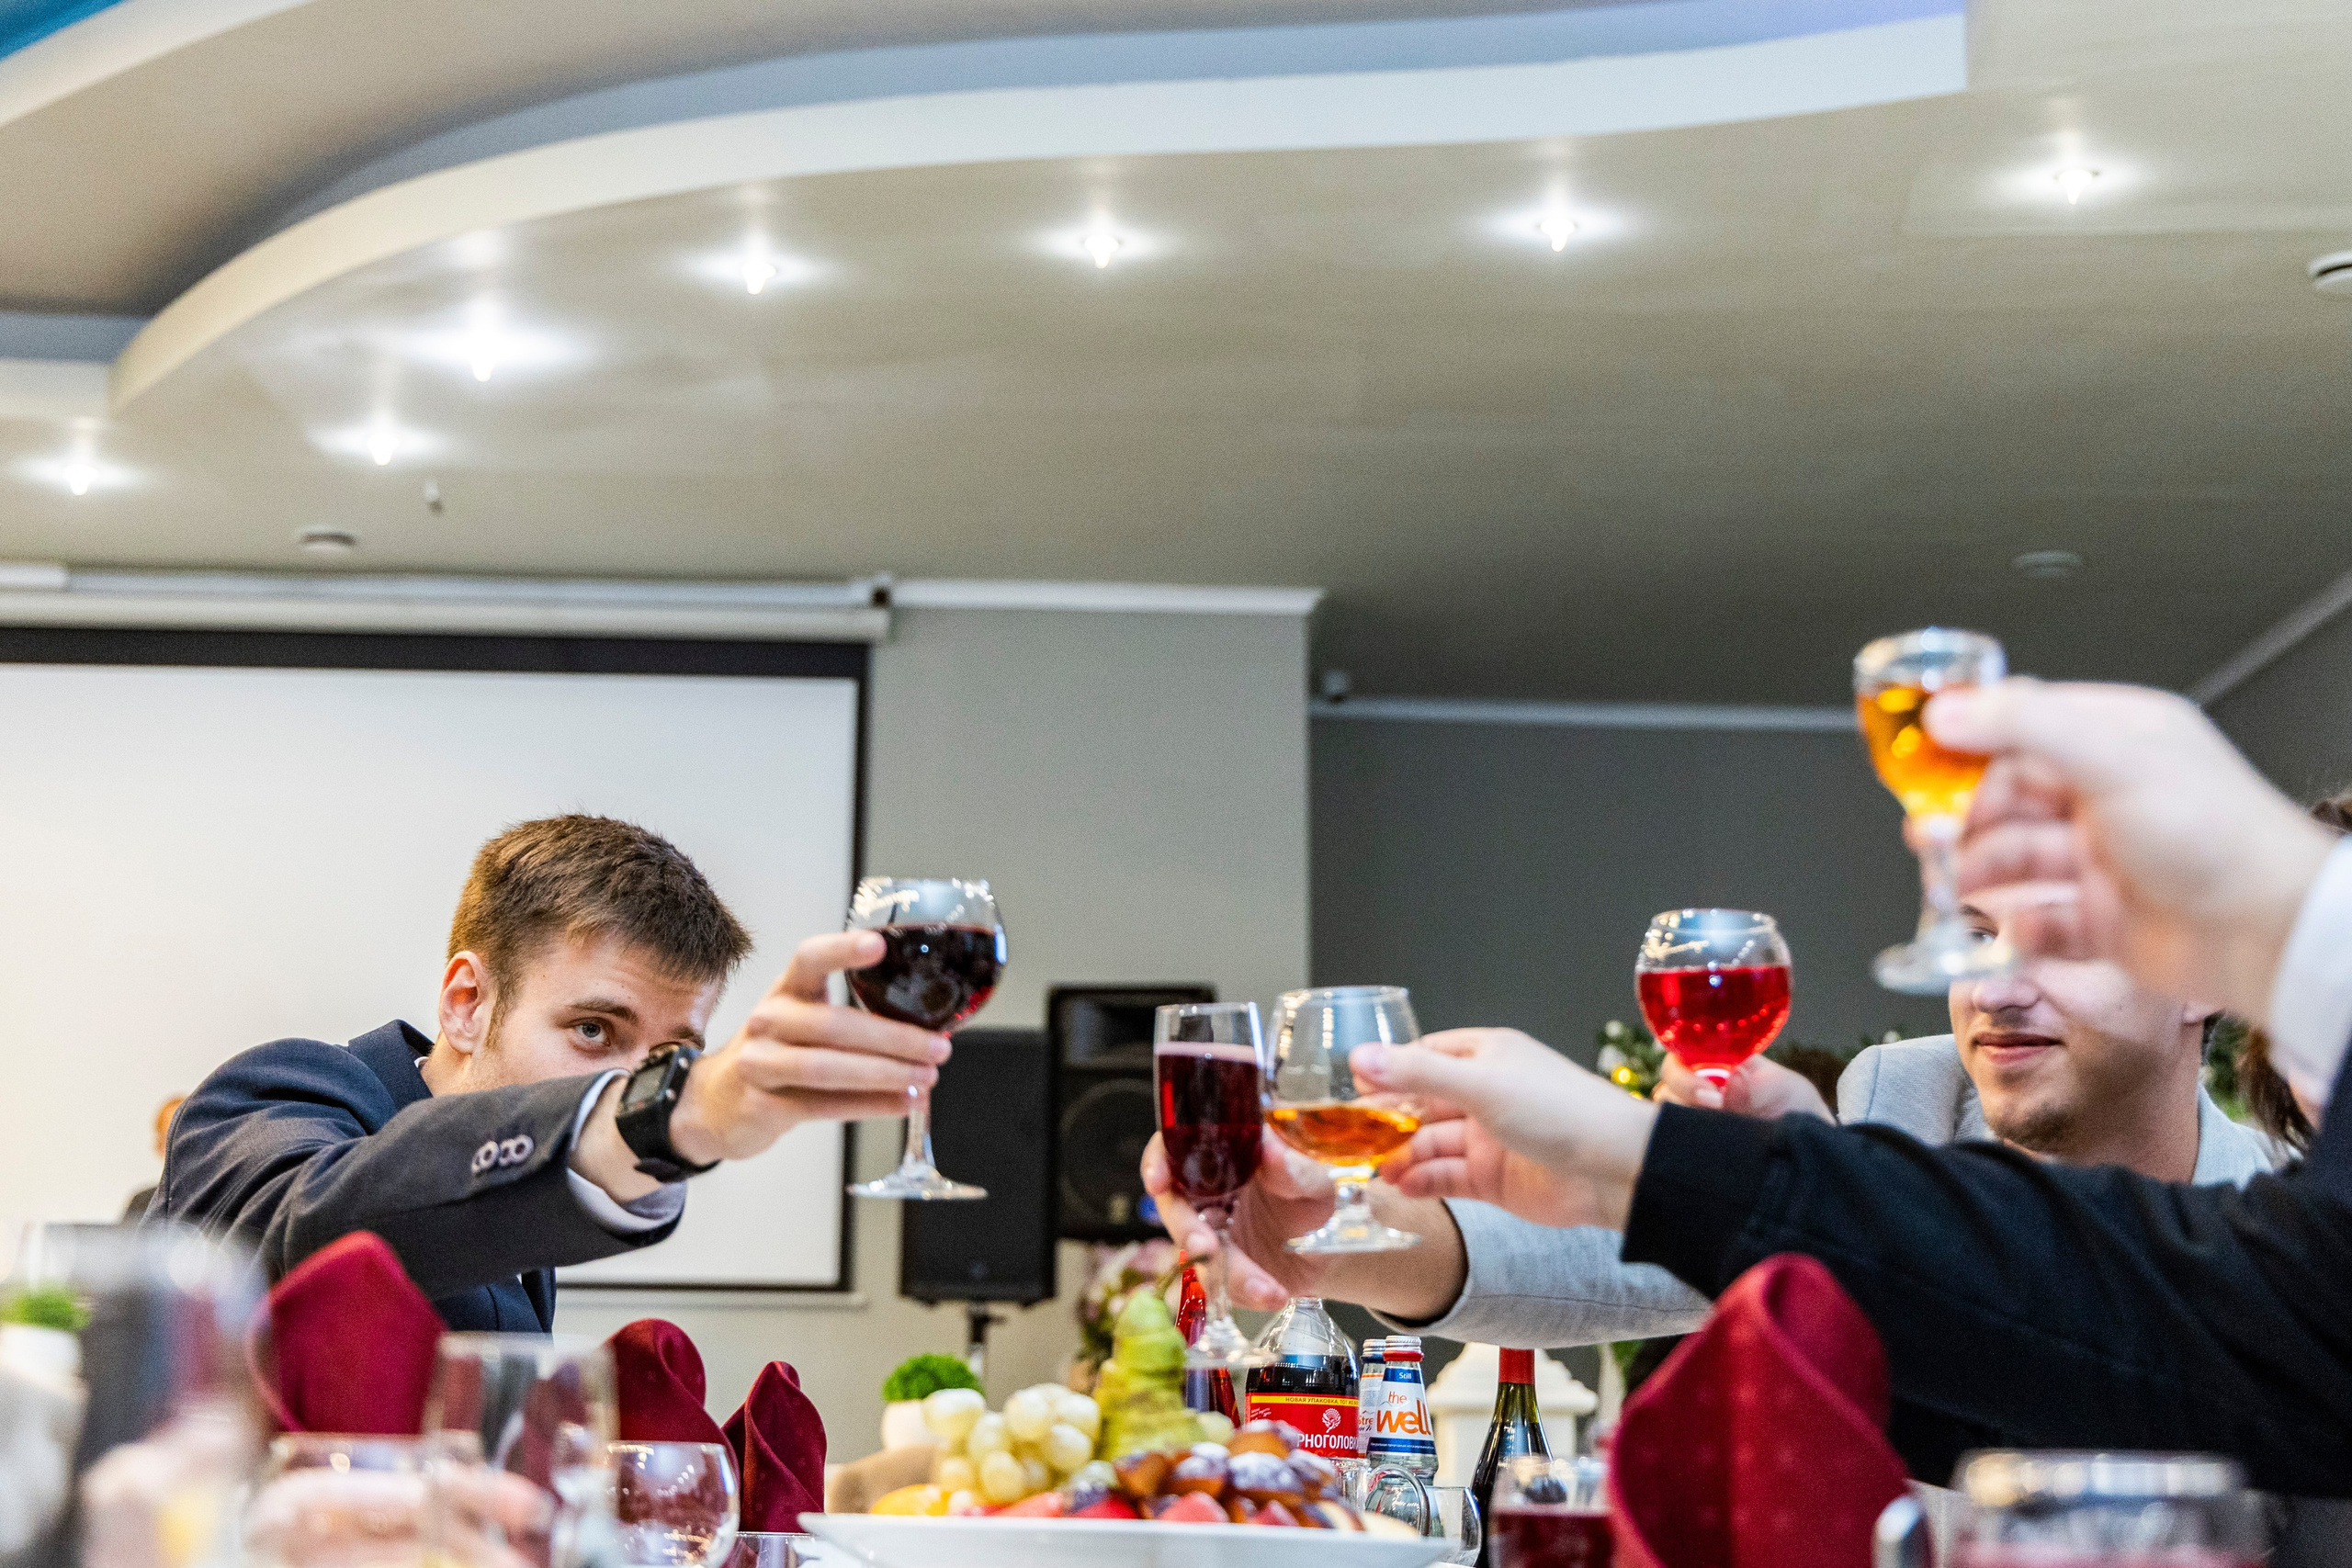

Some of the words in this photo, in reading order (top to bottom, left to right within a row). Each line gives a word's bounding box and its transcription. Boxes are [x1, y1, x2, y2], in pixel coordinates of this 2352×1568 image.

[1399, 1371, 1412, 1380] Still
[1388, 1391, 1408, 1404] the
[1376, 1399, 1431, 1435] well
[1296, 1433, 1359, 1450] РНОГОЛОВ
